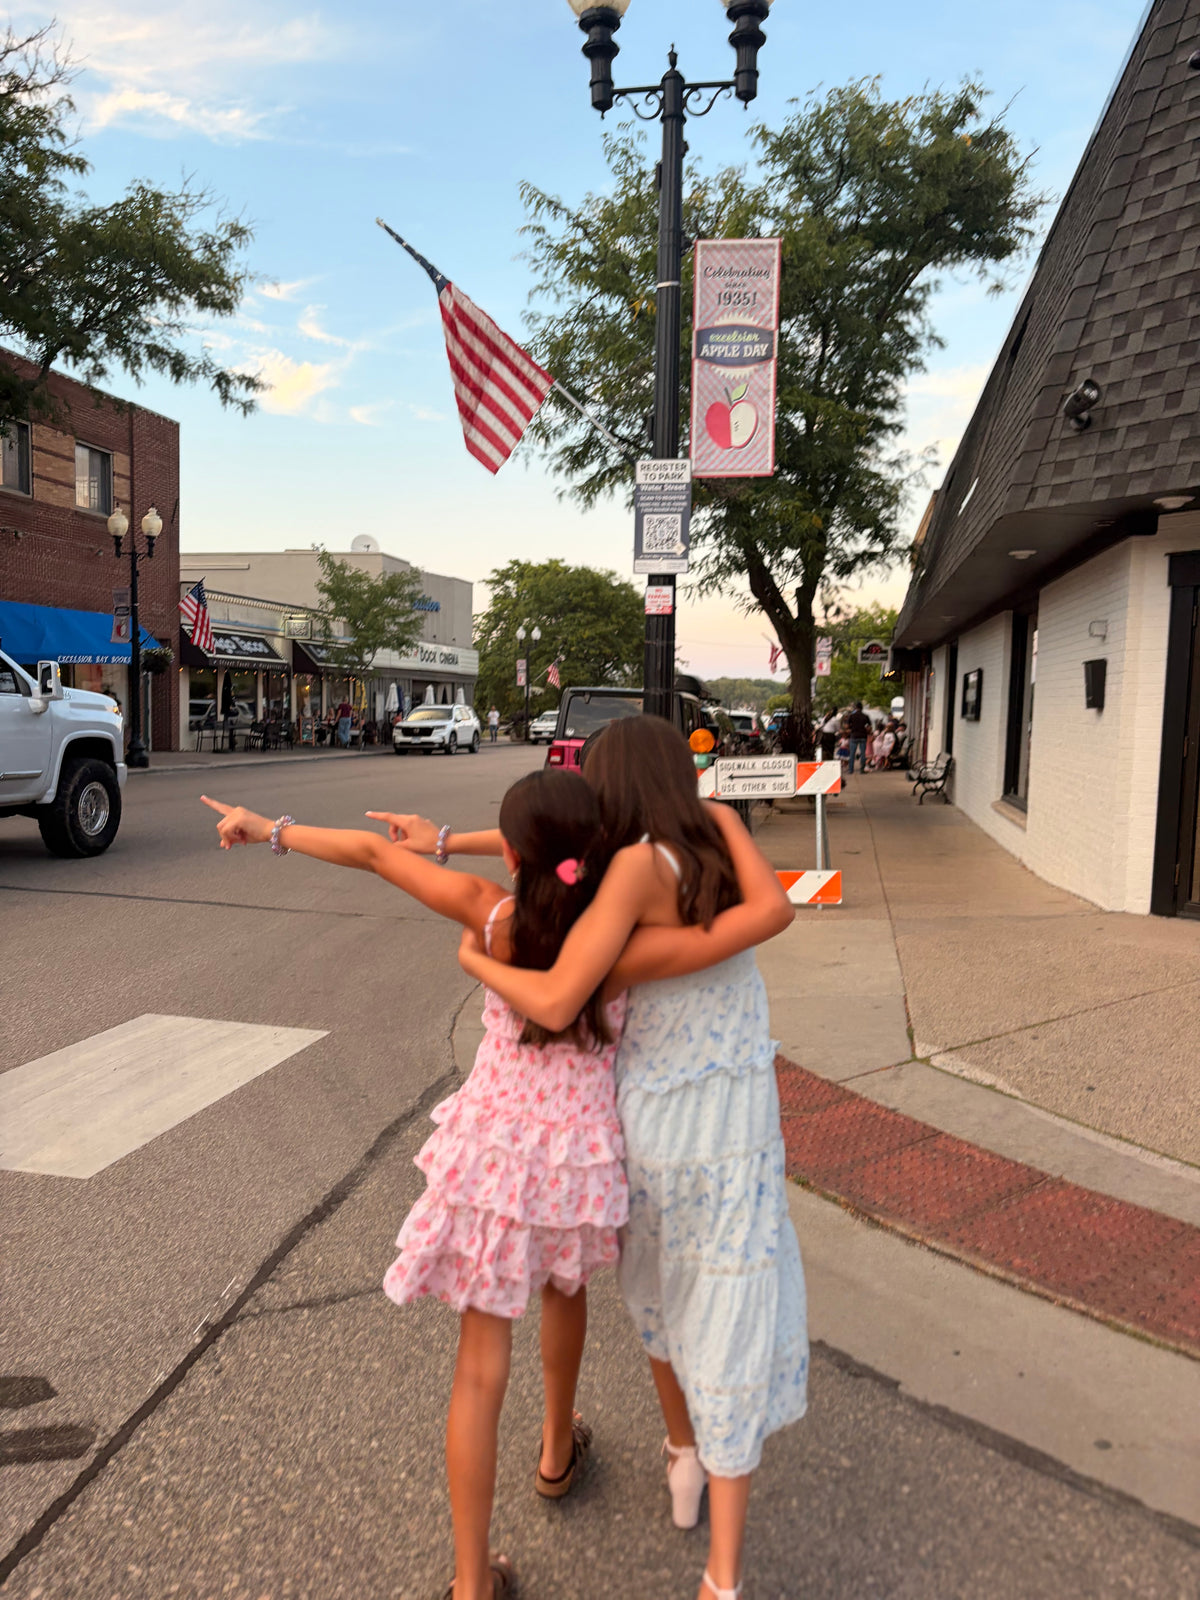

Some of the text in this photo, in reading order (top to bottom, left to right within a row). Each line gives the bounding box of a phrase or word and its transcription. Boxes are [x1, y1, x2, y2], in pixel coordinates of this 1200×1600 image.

[703, 265, 771, 279] Celebrating
[709, 330, 760, 343] excelsior
[700, 343, 769, 358] APPLE DAY
[640, 463, 687, 472] REGISTER
[643, 472, 684, 481] TO PARK
[664, 483, 687, 492] Street
[57, 655, 93, 664] EXCELSIOR
[96, 655, 109, 664] BAY
[420, 646, 437, 663] DOCK
[719, 760, 792, 772] SIDEWALK CLOSED
[721, 782, 790, 793] USE OTHER SIDE
